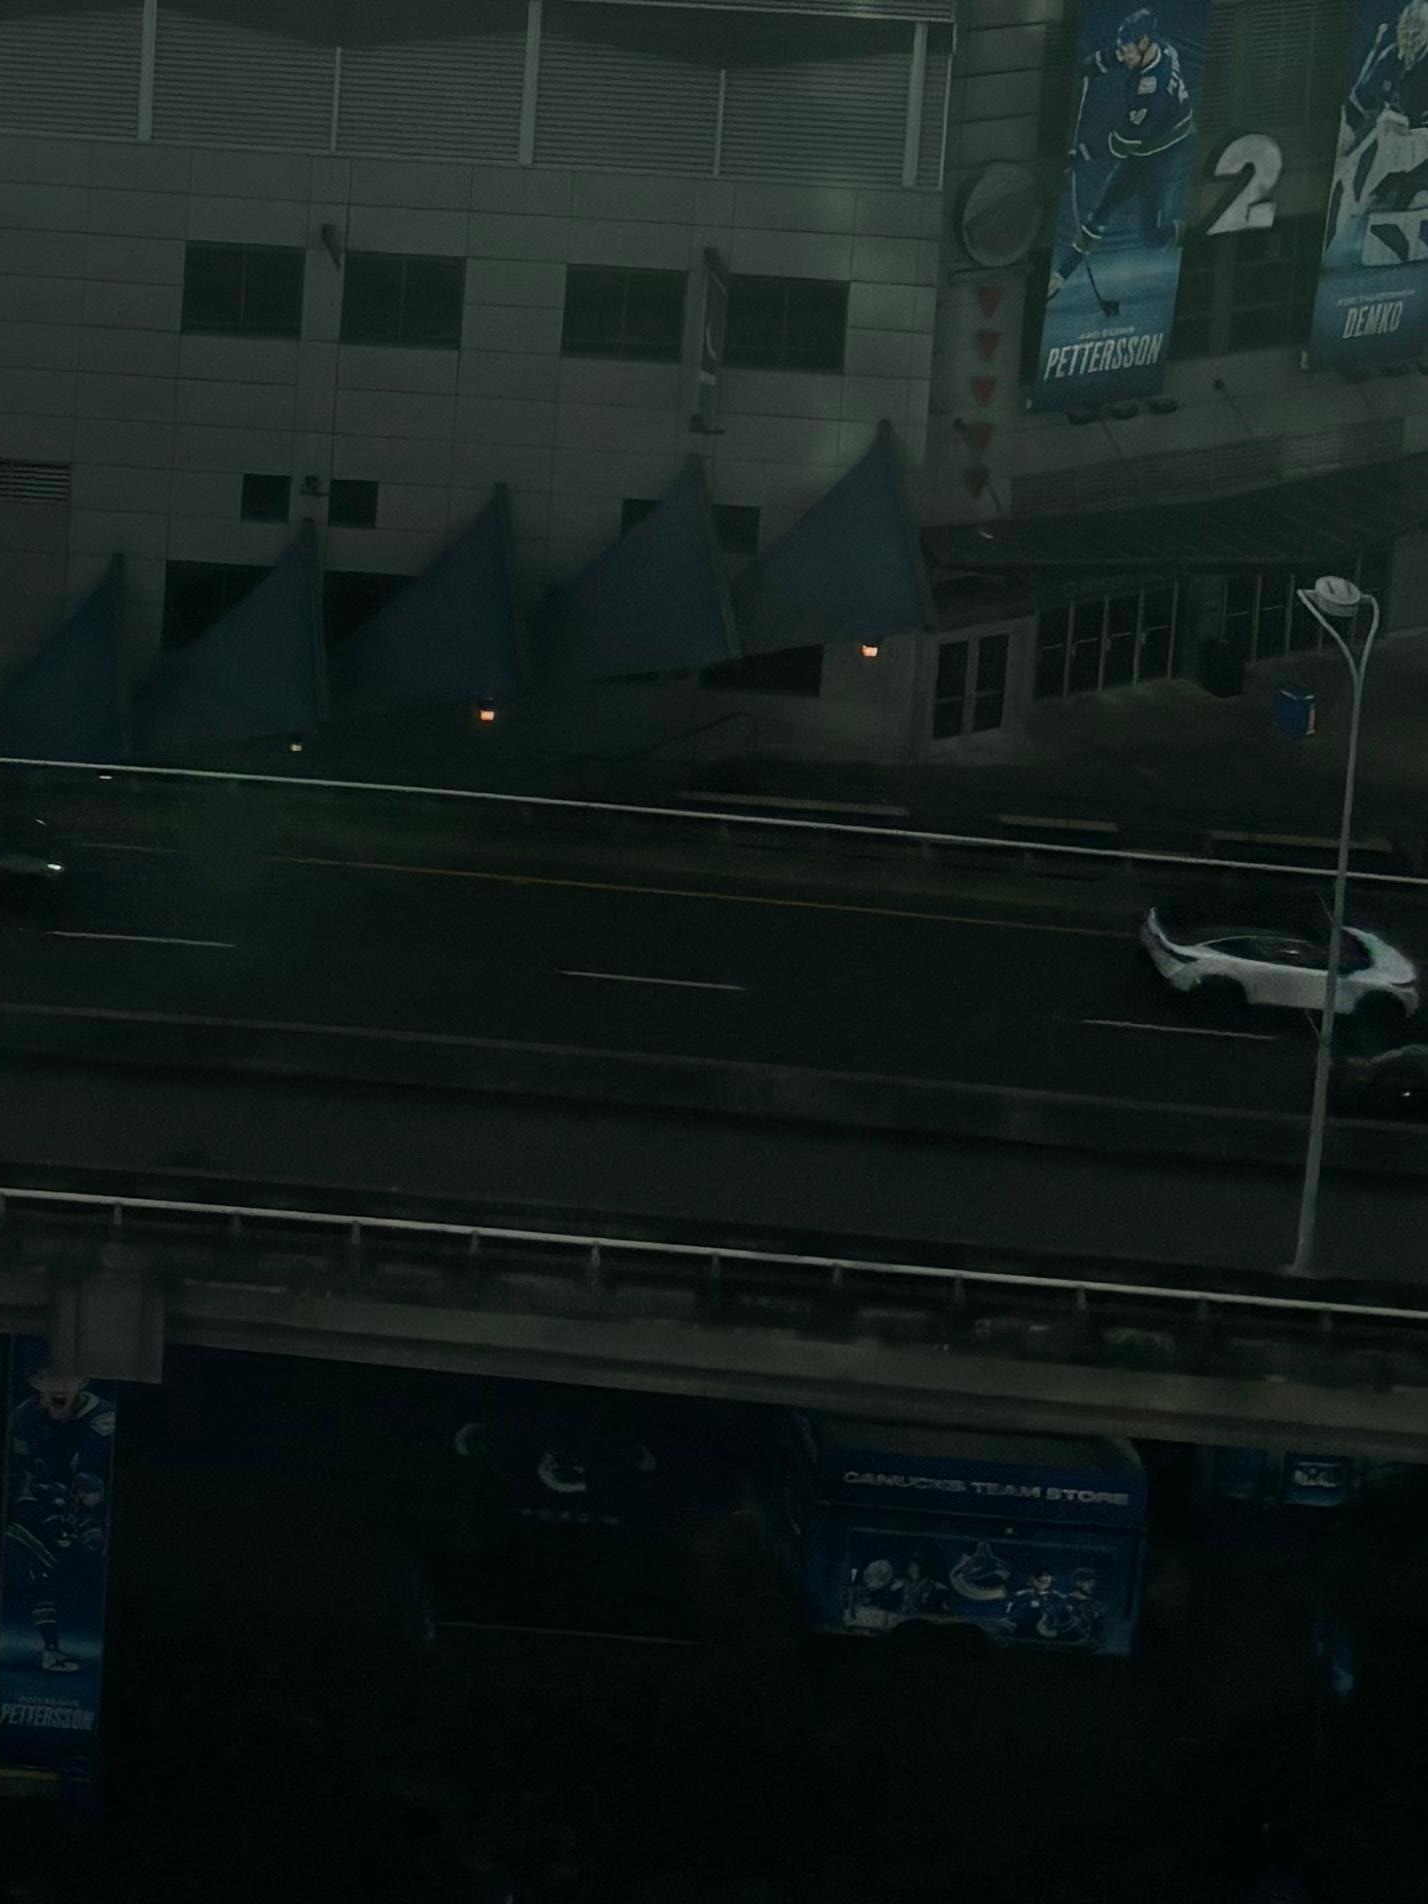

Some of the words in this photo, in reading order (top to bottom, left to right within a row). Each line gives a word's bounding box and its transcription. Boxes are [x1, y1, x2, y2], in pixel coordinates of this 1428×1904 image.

[1205, 133, 1283, 236] 2
[1341, 300, 1404, 340] DEMKO
[1043, 332, 1164, 381] PETTERSSON
